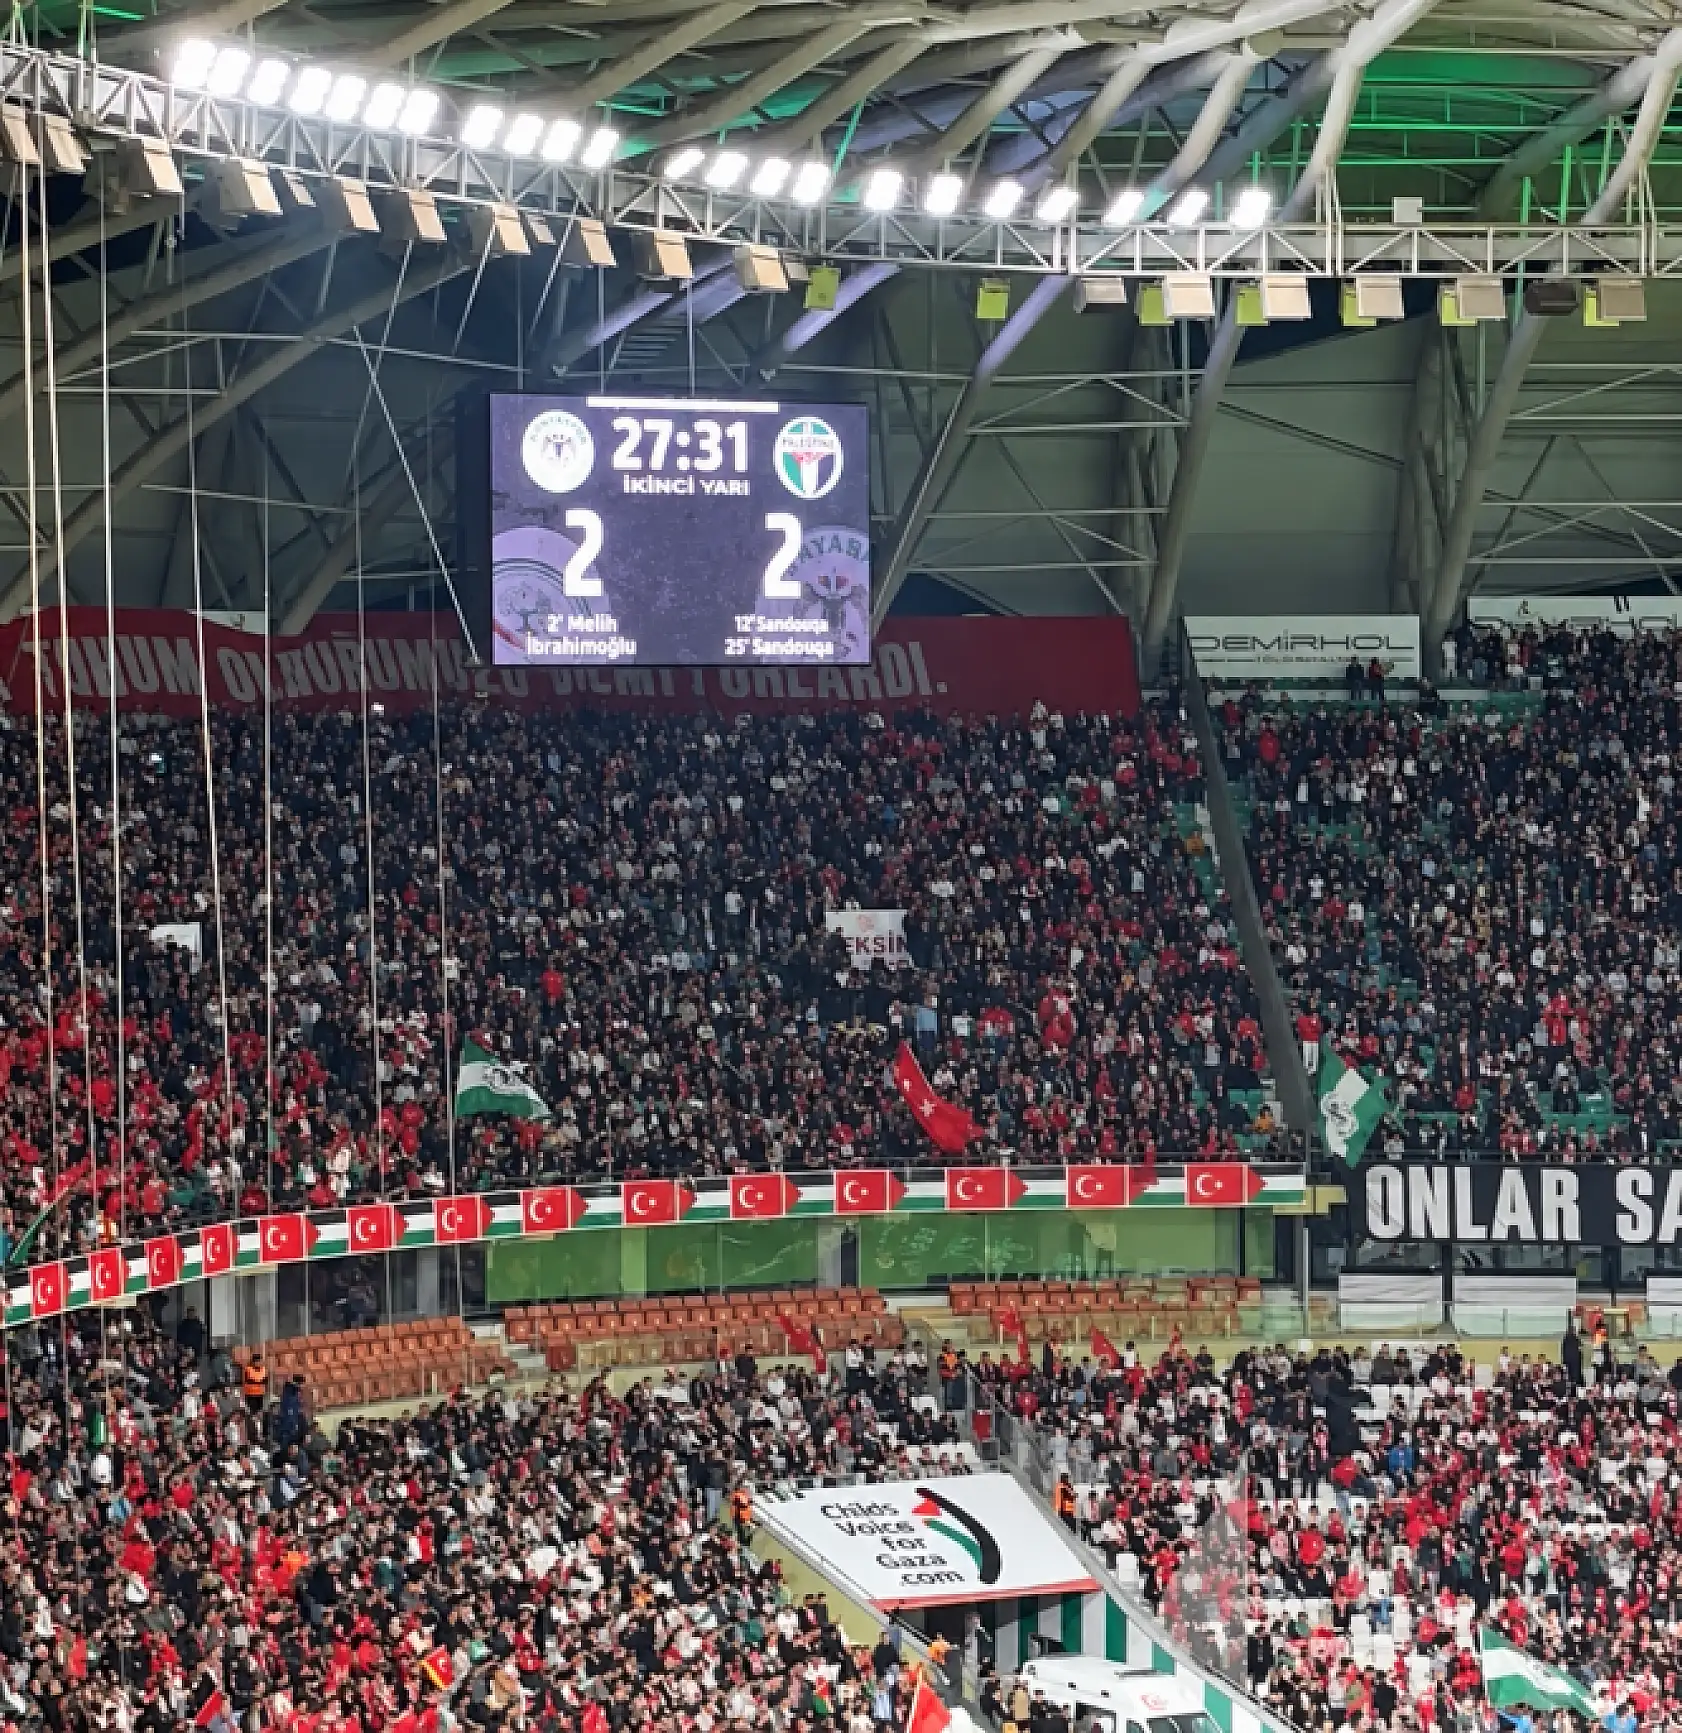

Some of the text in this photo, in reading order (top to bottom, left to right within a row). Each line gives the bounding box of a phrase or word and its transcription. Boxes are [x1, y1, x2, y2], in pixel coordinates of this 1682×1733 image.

[612, 416, 748, 472] 27:31
[623, 473, 750, 497] İKİNCİ YARI
[564, 508, 603, 597] 2
[764, 512, 801, 599] 2
[568, 613, 617, 632] Melih
[526, 631, 637, 659] İbrahimoğlu
[1366, 1164, 1581, 1241] ONLAR
[820, 1501, 899, 1518] Childs
[881, 1536, 927, 1551] for
[876, 1553, 947, 1569] Gaza
[900, 1571, 965, 1586] .com
